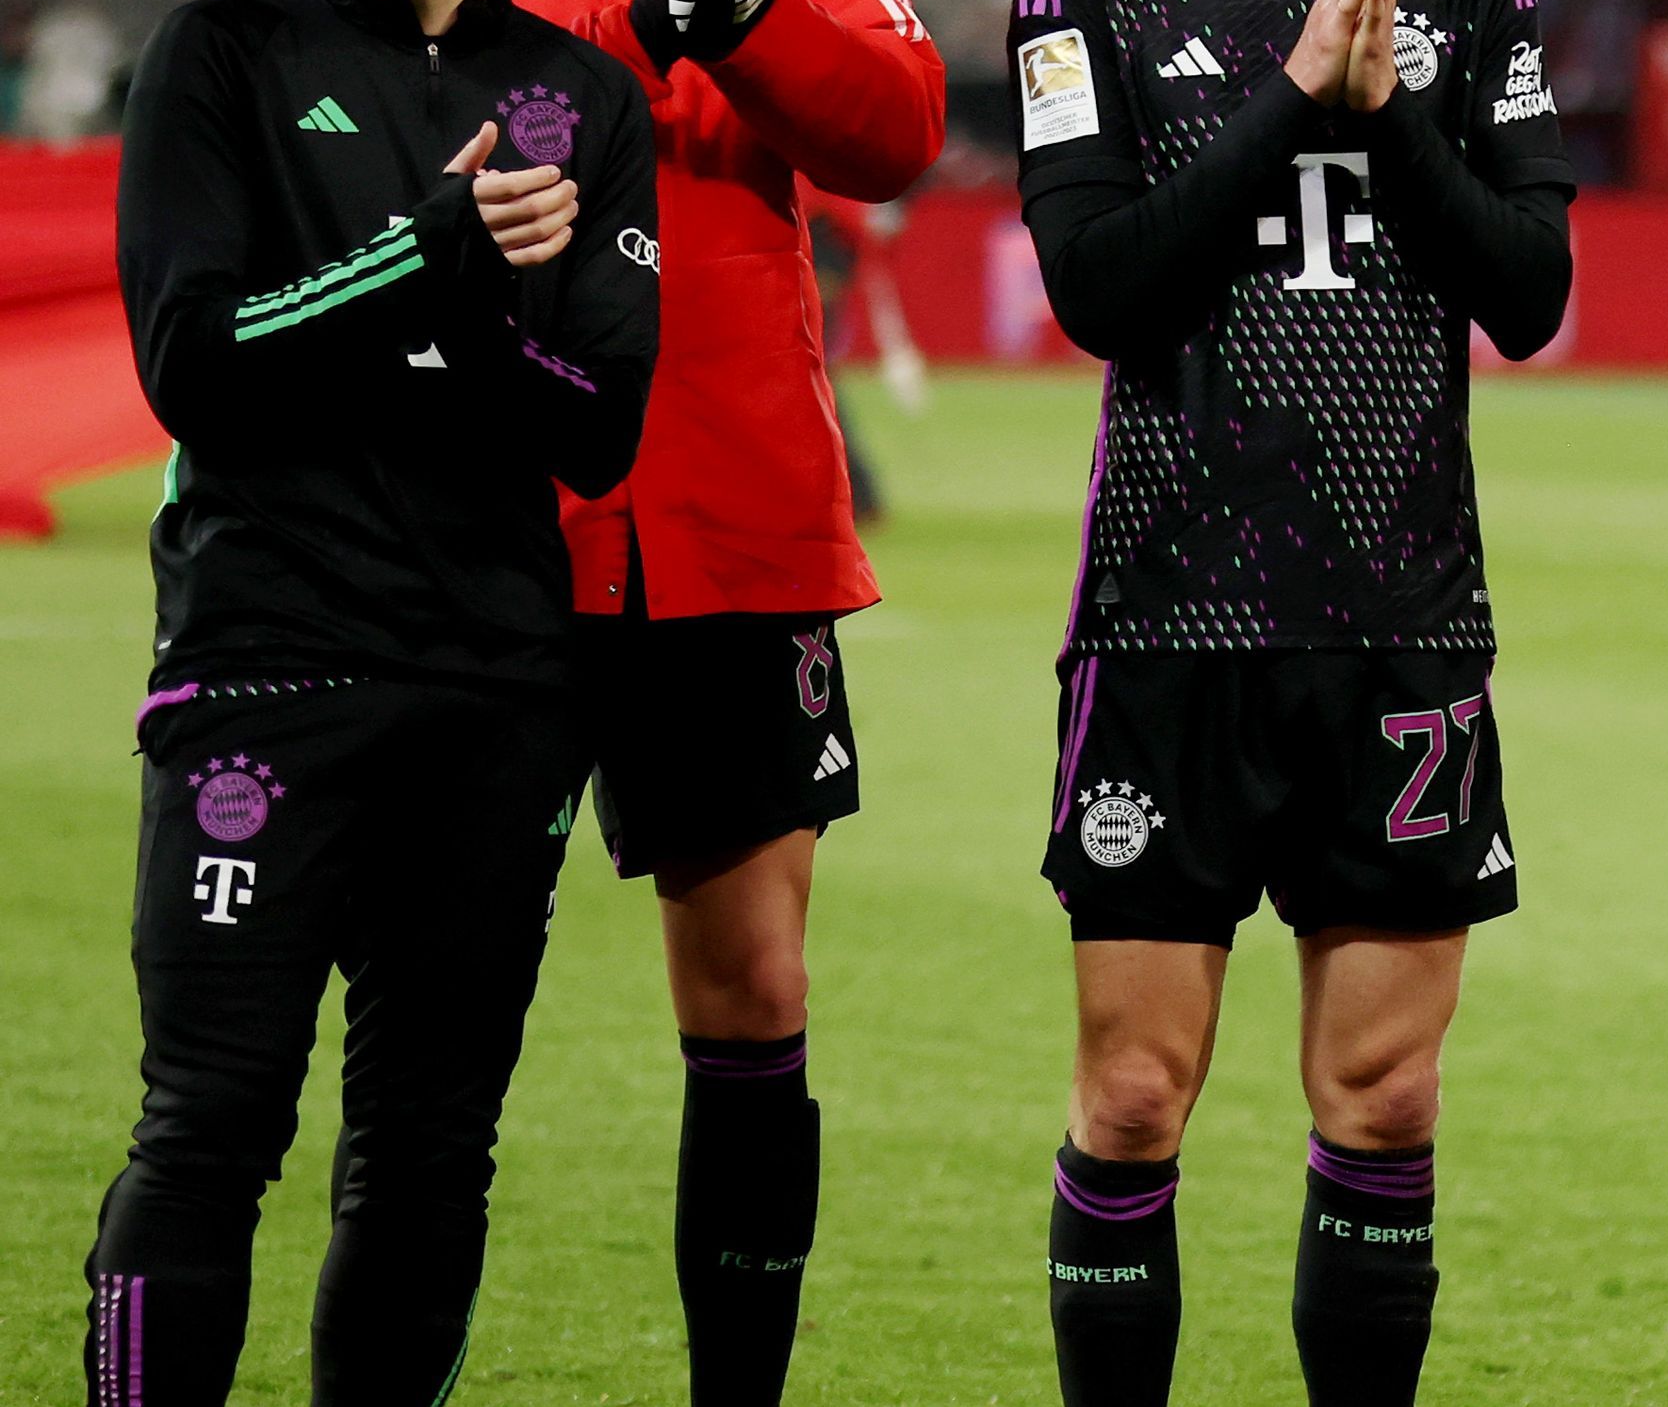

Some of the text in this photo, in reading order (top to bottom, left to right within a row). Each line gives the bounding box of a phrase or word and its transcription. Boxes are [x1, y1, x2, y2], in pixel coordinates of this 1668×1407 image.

[1395, 31, 1430, 55] AYERN
[1029, 90, 1087, 115] BUNDESLIGA
[1381, 693, 1484, 843] 27
[1090, 802, 1144, 834] FC BAYERN
[193, 854, 257, 925] T
[1318, 1213, 1352, 1238] FC
[1054, 1263, 1149, 1284] BAYERN
